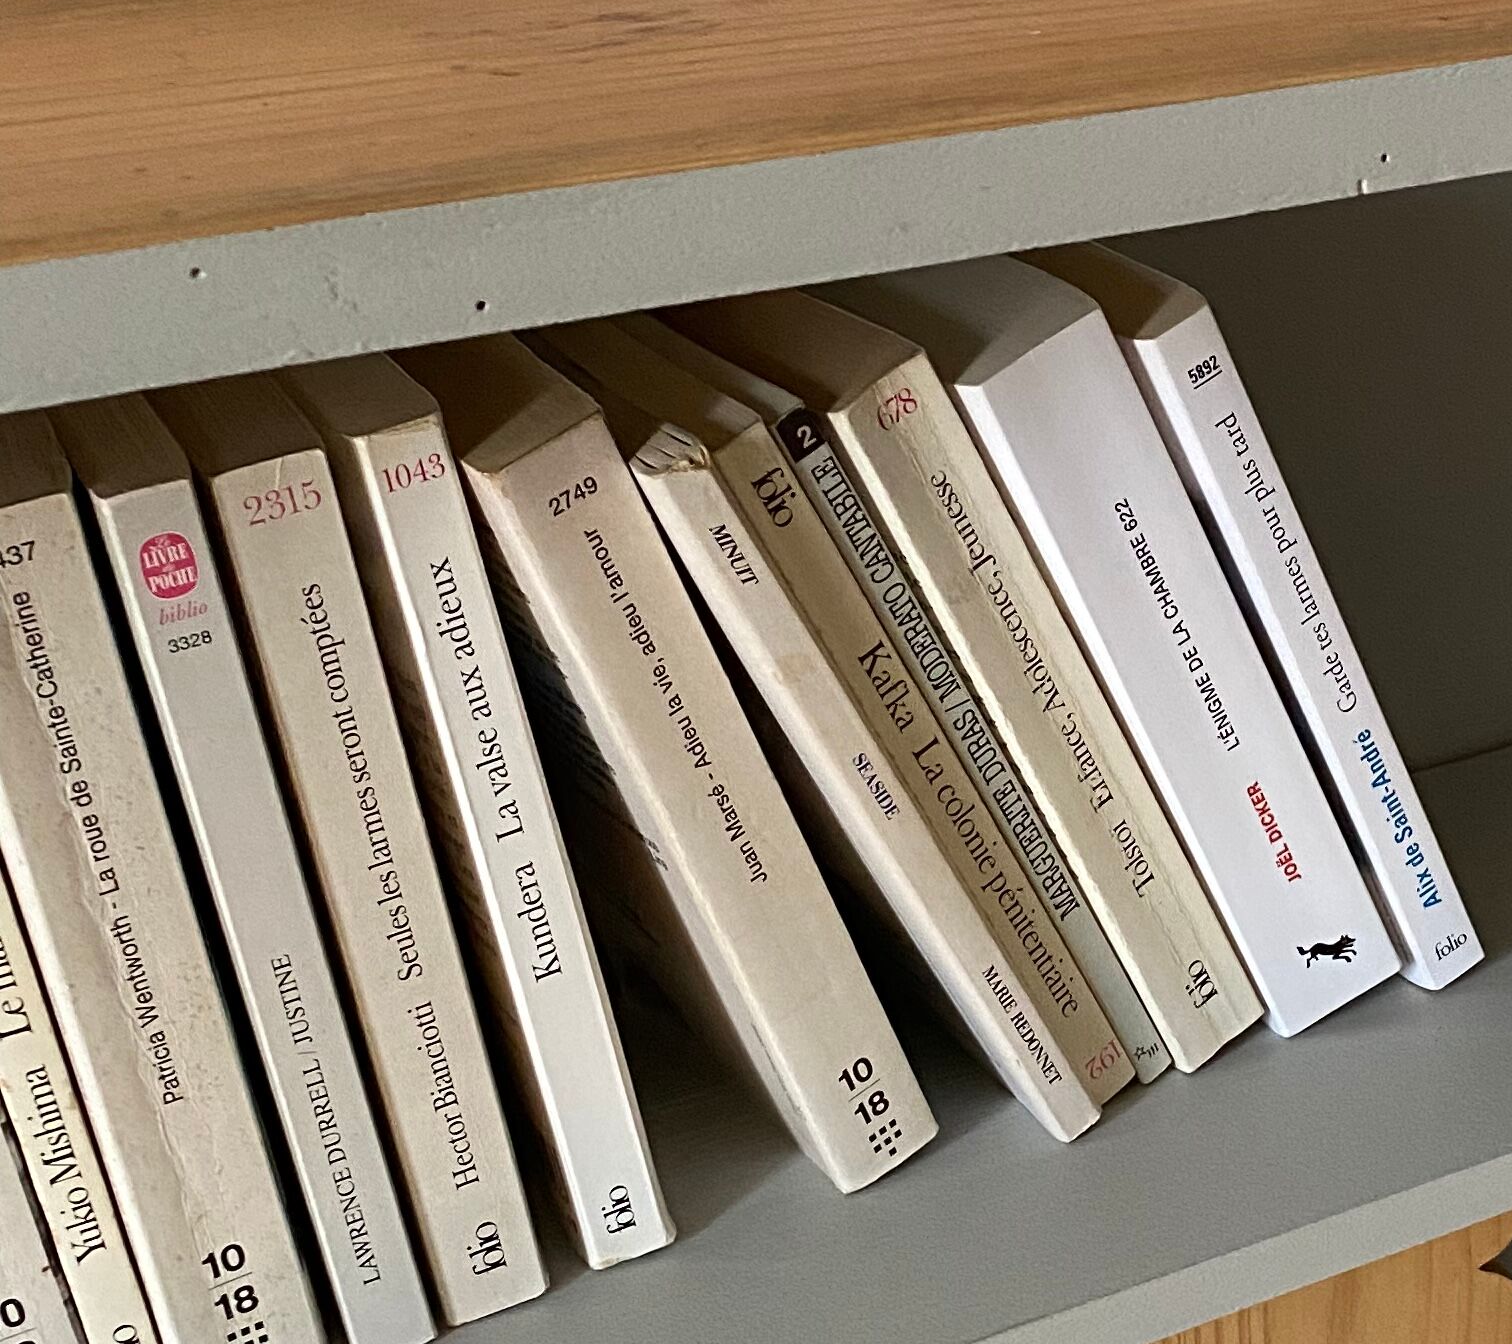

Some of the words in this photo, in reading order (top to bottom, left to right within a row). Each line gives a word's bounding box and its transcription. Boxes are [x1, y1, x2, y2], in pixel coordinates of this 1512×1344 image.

[1188, 355, 1220, 384] 5892
[797, 424, 817, 449] 2
[877, 388, 918, 431] 678
[1215, 412, 1249, 457] tard
[382, 453, 446, 493] 1043
[548, 476, 598, 517] 2749
[751, 467, 796, 528] folio
[1243, 459, 1275, 502] plus
[244, 479, 322, 526] 2315
[811, 456, 894, 584] CANTABILE
[931, 470, 997, 575] Jeunesse
[1115, 498, 1138, 532] 622
[1263, 506, 1298, 554] pour
[142, 543, 188, 569] LIVRE
[148, 566, 196, 593] POCHE
[584, 528, 630, 604] l'amour
[709, 524, 759, 586] MINUIT
[1130, 532, 1179, 619] CHAMBRE
[160, 601, 208, 625] biblio
[430, 556, 474, 659] adieux
[1285, 556, 1320, 625] larmes
[168, 630, 212, 653] 3328
[301, 583, 349, 703] comptées
[622, 603, 656, 656] adieu
[883, 582, 961, 703] MODERATO
[1173, 620, 1191, 646] LA
[1313, 622, 1332, 651] tes
[13, 591, 81, 774] Sainte-Catherine
[653, 657, 674, 694] vie,
[858, 639, 915, 734] Kafka
[1183, 646, 1204, 673] DE
[1323, 652, 1357, 712] Garde
[460, 664, 492, 721] aux
[668, 693, 685, 717] la
[1195, 672, 1240, 751] L'ÉNIGME
[332, 706, 371, 784] seront
[476, 727, 512, 797] valse
[678, 716, 713, 769] Adieu
[952, 708, 1006, 786] DURAS
[70, 780, 92, 807] de
[707, 783, 746, 842] Marsé
[853, 752, 900, 821] SEASIDE
[1247, 781, 1283, 844] DICKER
[1353, 729, 1412, 844] Saint-André
[82, 814, 110, 862] roue
[357, 786, 394, 871] larmes
[495, 799, 525, 843] La
[740, 840, 768, 883] Juan
[912, 736, 944, 785] La
[937, 784, 997, 873] colonie
[981, 870, 1080, 1018] pénitentiaire
[993, 779, 1080, 921] MARGUERITE
[1276, 843, 1301, 882] JOËL
[1406, 843, 1424, 867] de
[99, 867, 120, 896] La
[377, 870, 403, 906] les
[1416, 867, 1442, 909] Alix
[387, 905, 423, 981] Seules
[515, 861, 563, 983] Kundera
[1435, 932, 1467, 960] folio
[110, 915, 159, 1028] Wentworth
[271, 953, 313, 1045] JUSTINE
[0, 997, 32, 1041] Le
[981, 964, 1017, 1014] MARIE
[1010, 1011, 1063, 1085] REDONNET
[148, 1031, 183, 1104] Patricia
[407, 1001, 459, 1112] Bianciotti
[838, 1056, 873, 1092] 10
[25, 1064, 82, 1186] Mishima
[303, 1058, 347, 1166] DURRELL
[854, 1090, 891, 1125] 18
[444, 1112, 480, 1190] Hector
[60, 1187, 107, 1266] Yukio
[333, 1167, 382, 1285] LAWRENCE
[600, 1184, 637, 1235] folio
[202, 1244, 245, 1279] 10
[466, 1221, 508, 1276] folio
[214, 1285, 259, 1320] 18
